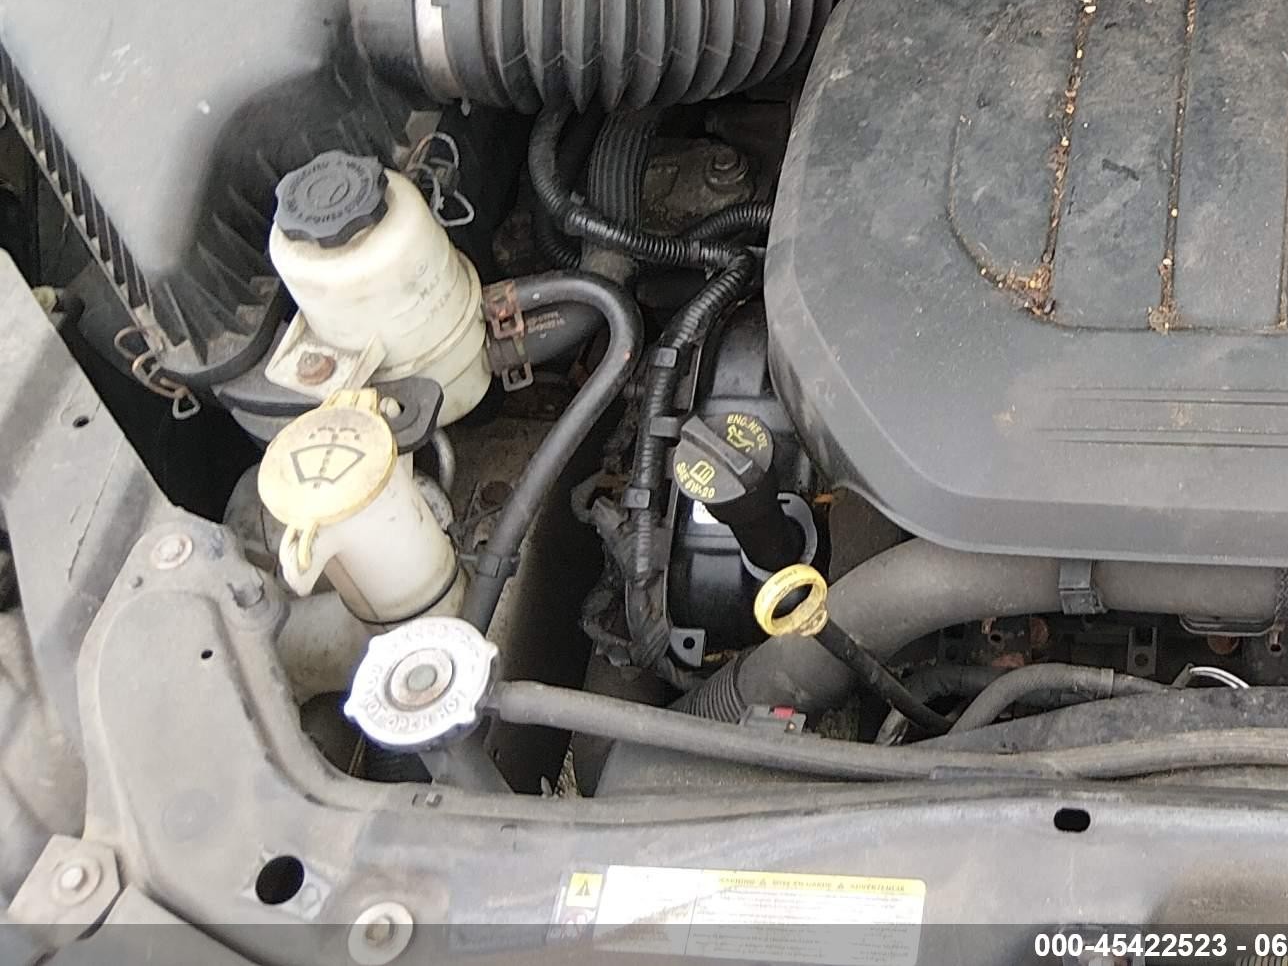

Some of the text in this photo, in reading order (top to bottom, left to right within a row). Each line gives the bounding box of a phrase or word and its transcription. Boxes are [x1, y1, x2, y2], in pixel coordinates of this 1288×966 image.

[727, 413, 768, 451] ENGINE OIL
[385, 714, 433, 731] OPEN
